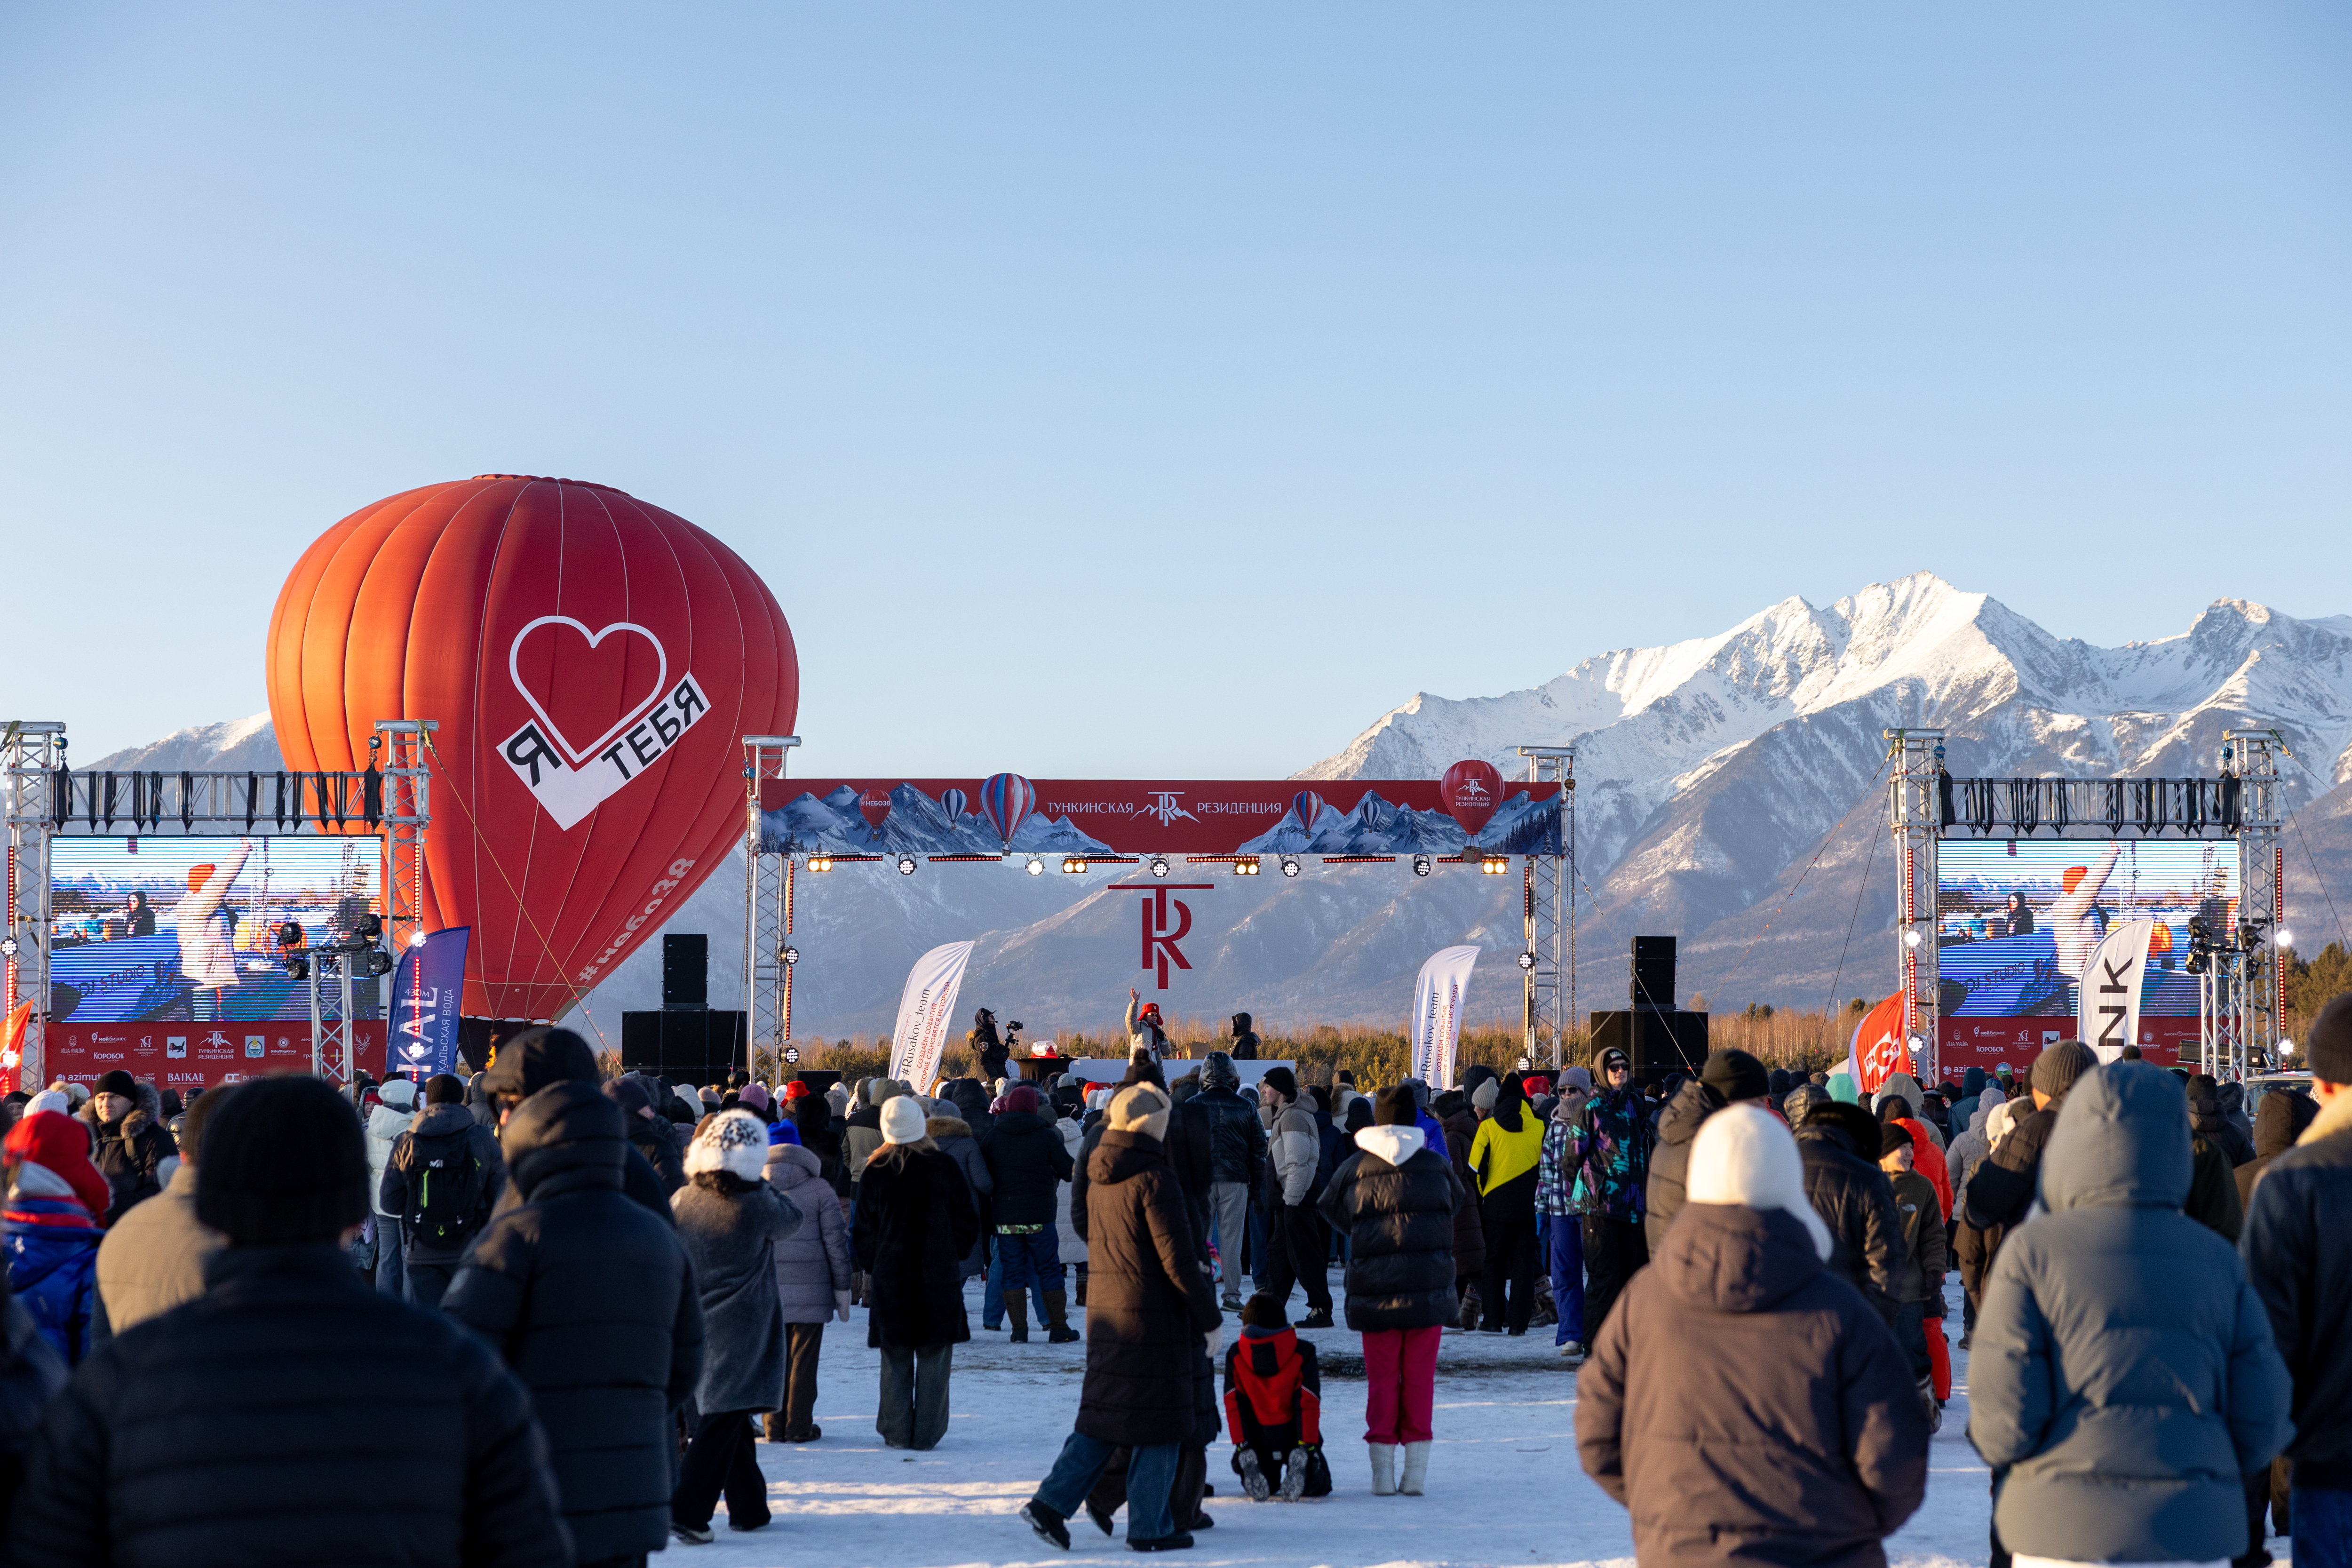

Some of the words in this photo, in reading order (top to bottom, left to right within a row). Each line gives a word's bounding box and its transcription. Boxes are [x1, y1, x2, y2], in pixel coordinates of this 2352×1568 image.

[506, 724, 562, 788] Я
[600, 678, 705, 780] ТЕБЯ
[1047, 802, 1133, 813] ТУНКИНСКАЯ
[1197, 802, 1281, 814] РЕЗИДЕНЦИЯ
[101, 965, 144, 991] STUDIO
[1985, 962, 2025, 987] STUDIO
[443, 989, 454, 1016] ВОДА
[901, 989, 930, 1076] #Rusakov_team
[917, 1037, 929, 1068] СОЗДАЁМ
[925, 1002, 939, 1034] СОБЫТИЯ,
[919, 1061, 930, 1091] КОТОРЫЕ
[927, 1018, 941, 1059] СТАНОВЯТСЯ
[938, 981, 951, 1016] ИСТОРИЕЙ
[1421, 993, 1439, 1080] #Rusakov_team
[1439, 1005, 1448, 1038] СОБЫТИЯ,
[1444, 1020, 1453, 1062] СТАНОВЯТСЯ
[1449, 984, 1458, 1019] ИСТОРИЕЙ
[167, 1073, 205, 1082] BAIKAL
